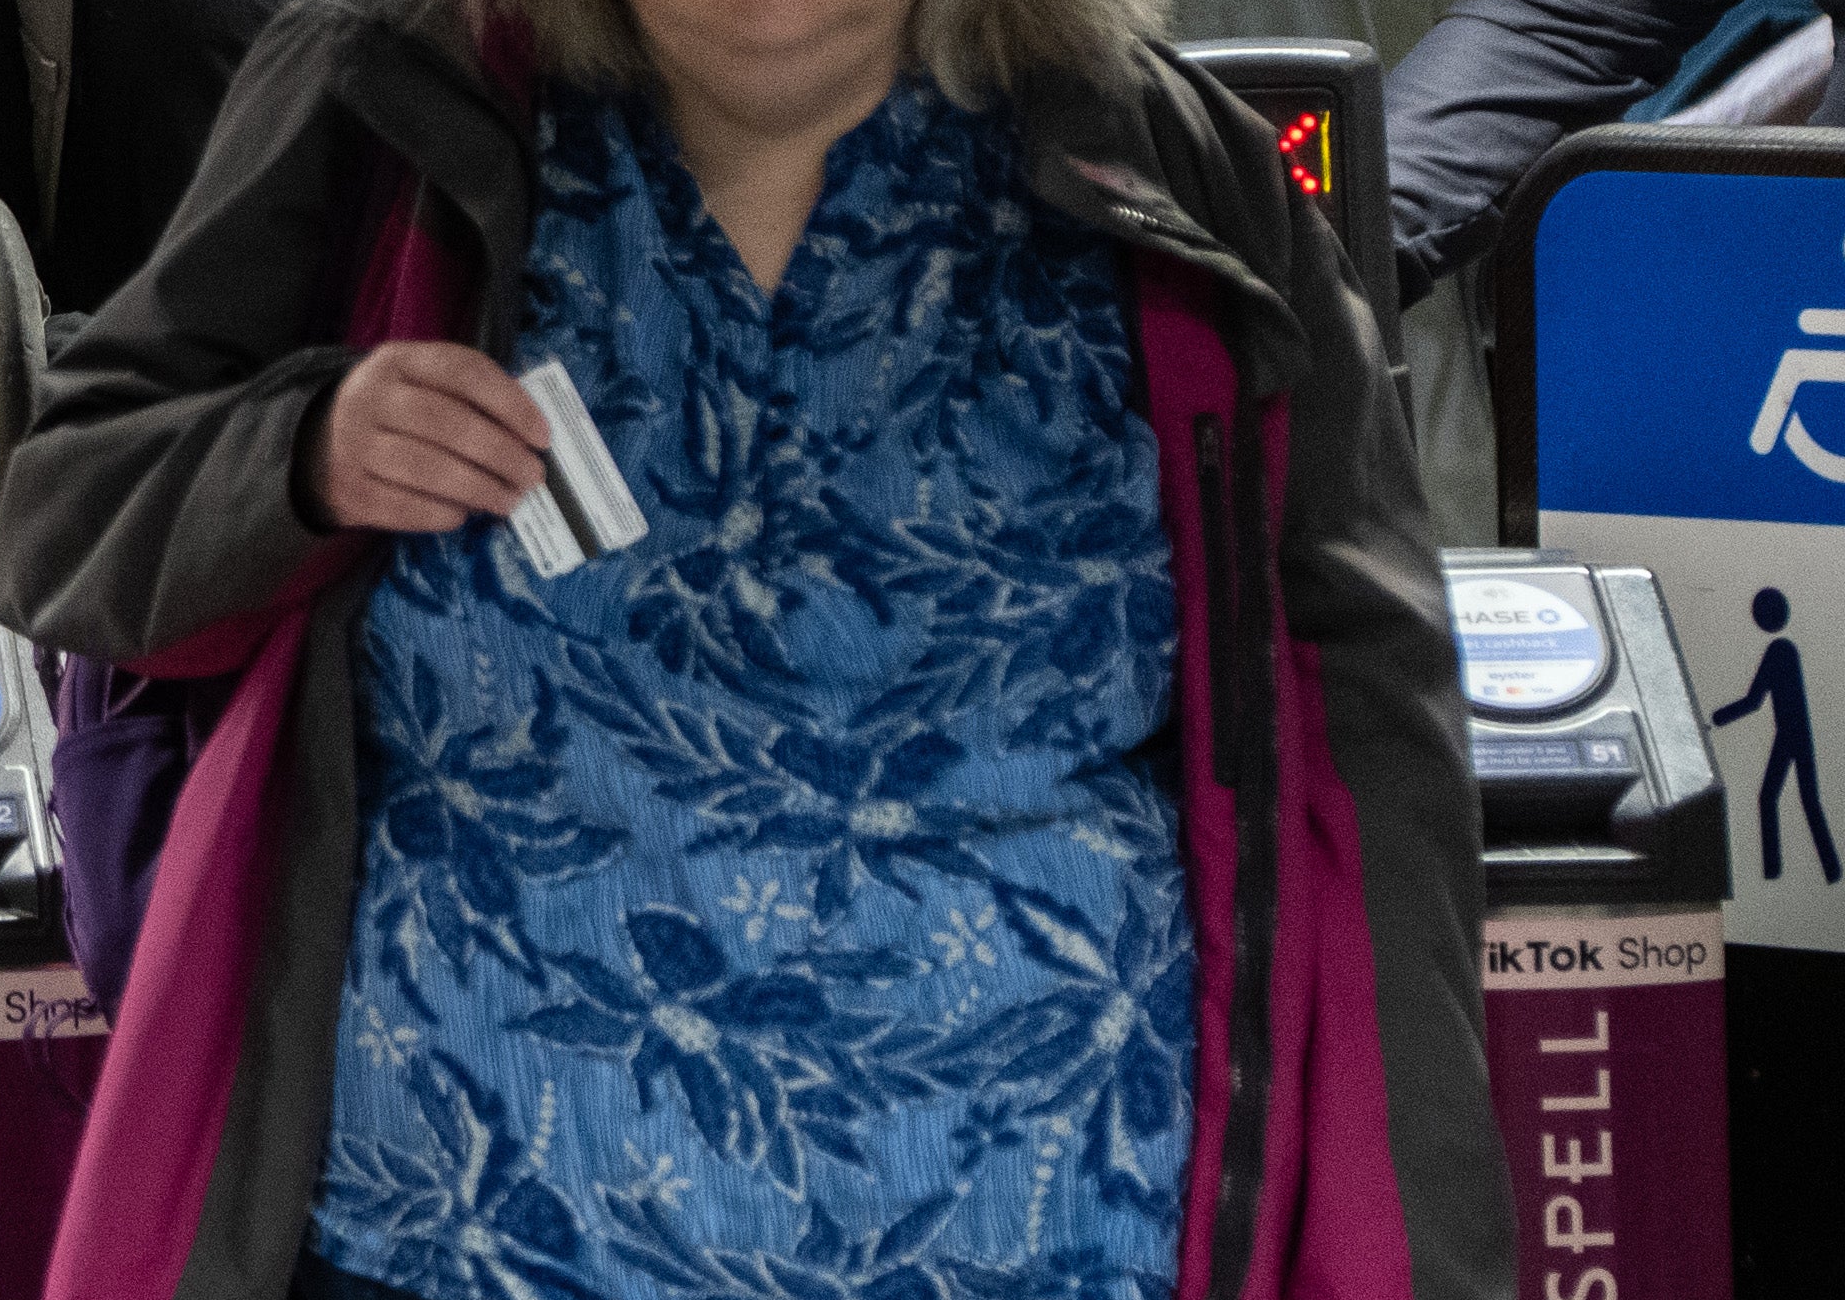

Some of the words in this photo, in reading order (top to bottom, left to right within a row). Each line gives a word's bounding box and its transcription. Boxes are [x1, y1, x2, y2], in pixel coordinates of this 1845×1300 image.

[1457, 610, 1531, 624] HASE
[1484, 940, 1603, 974] ikTok
[1618, 936, 1707, 974] Shop
